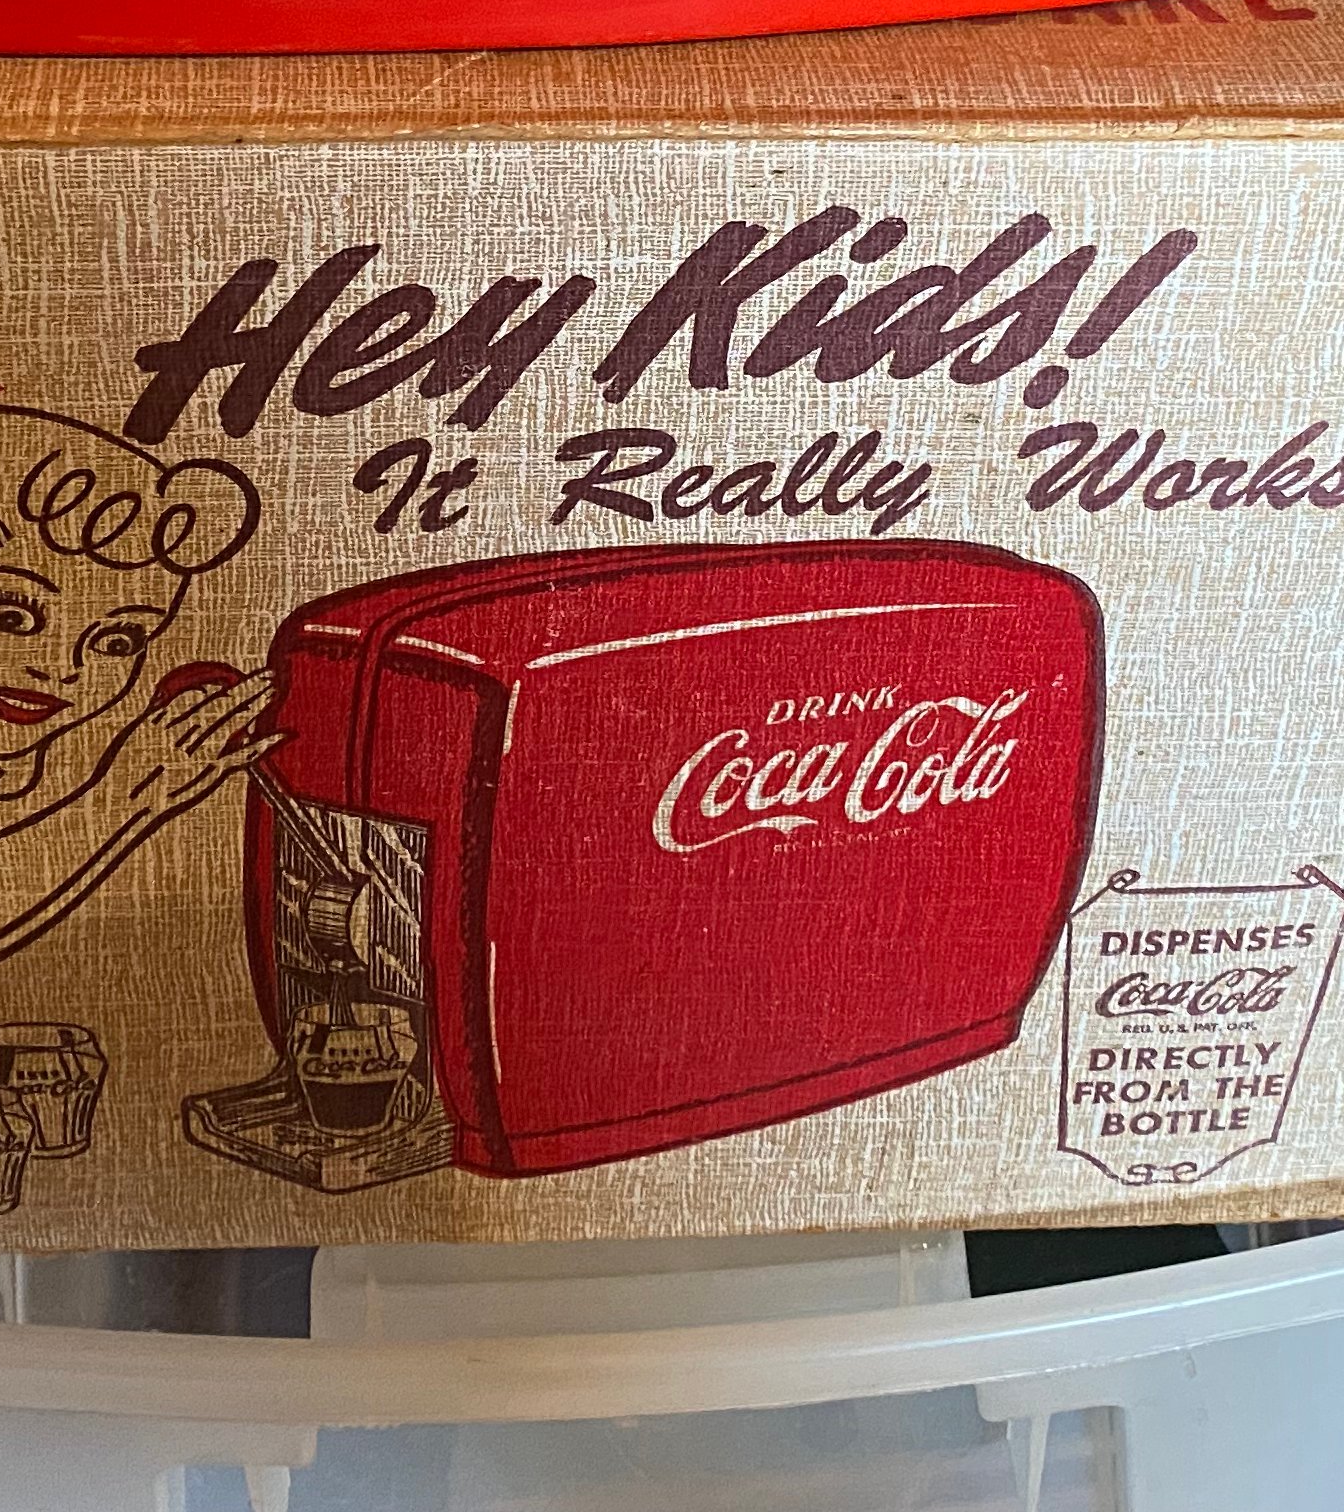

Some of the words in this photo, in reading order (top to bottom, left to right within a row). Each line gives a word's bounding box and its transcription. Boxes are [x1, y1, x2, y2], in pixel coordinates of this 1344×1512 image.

[122, 242, 597, 445] Hey
[591, 205, 1198, 409] Kids!
[352, 437, 479, 534] It
[549, 426, 932, 536] Really
[766, 683, 903, 725] DRINK
[1100, 923, 1316, 957] DISPENSES
[1088, 1042, 1282, 1072] DIRECTLY
[1072, 1078, 1190, 1105] FROM
[1214, 1073, 1286, 1101] THE
[1101, 1106, 1251, 1137] BOTTLE
